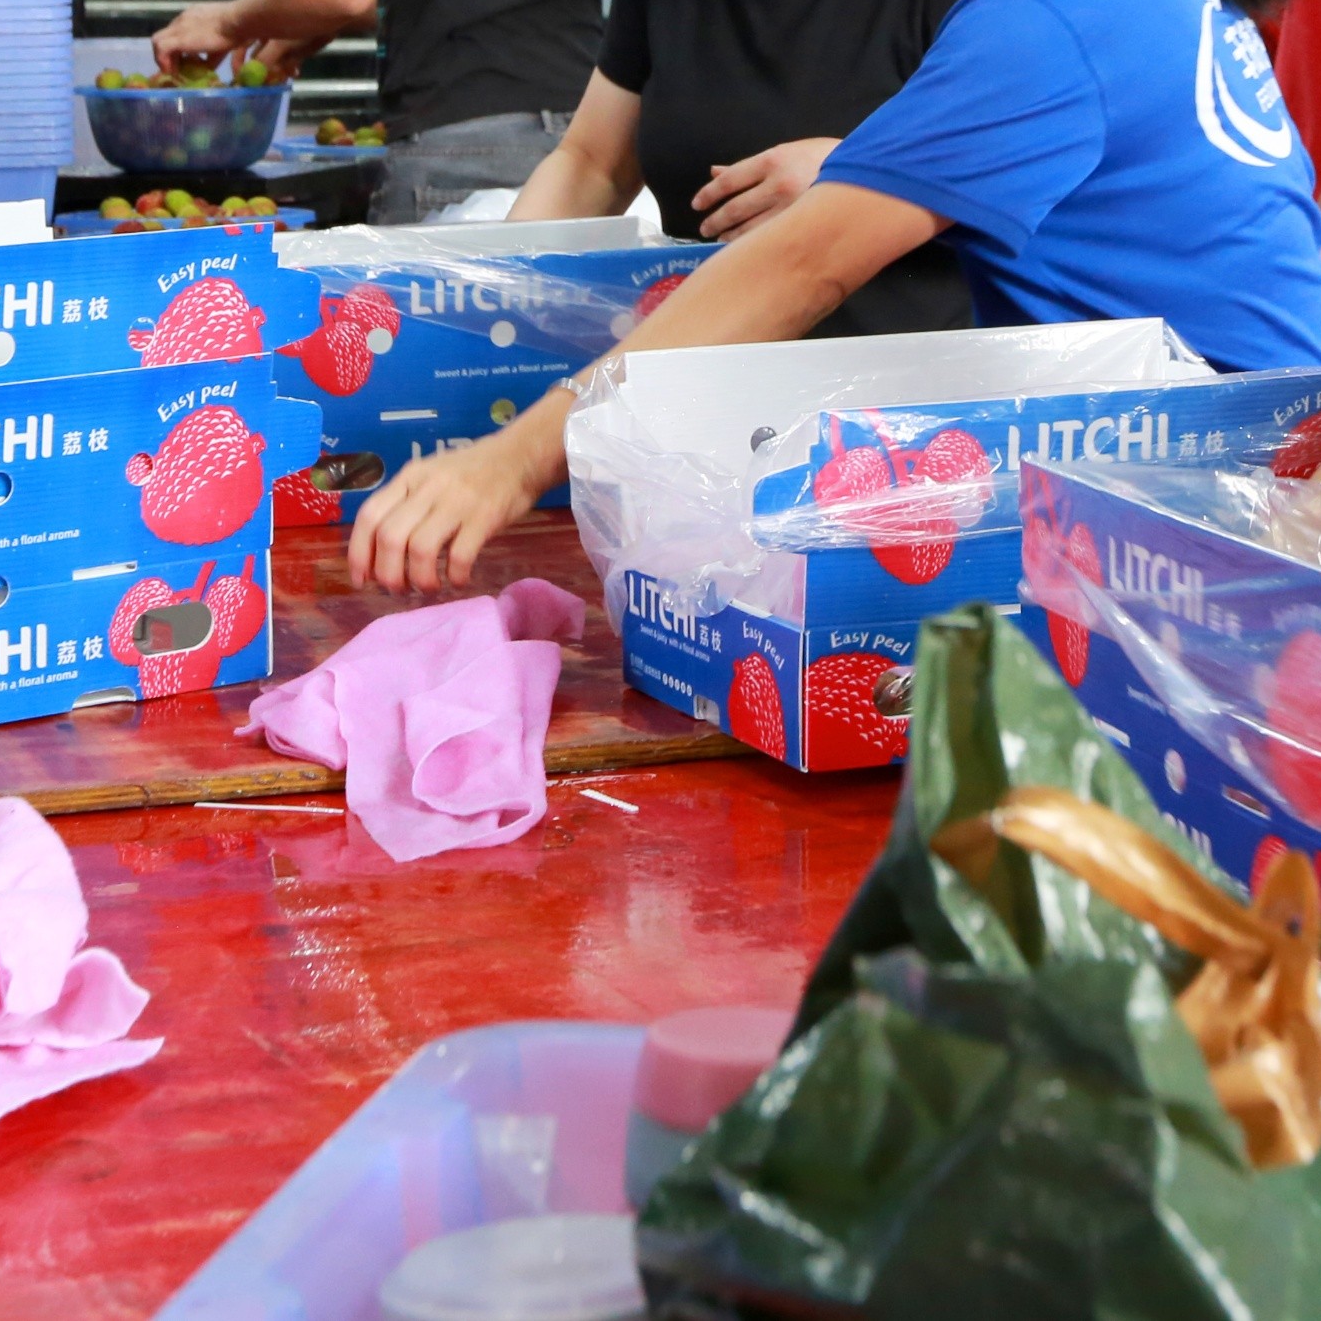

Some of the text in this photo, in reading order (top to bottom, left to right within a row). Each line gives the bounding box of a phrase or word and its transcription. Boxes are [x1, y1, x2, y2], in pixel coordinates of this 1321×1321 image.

[157, 253, 238, 293] Easy peel
[62, 296, 109, 324] 荔枝
[157, 380, 238, 423] Easy peel
[1274, 395, 1309, 426] Easy
[62, 427, 109, 457] 荔枝
[1007, 412, 1227, 471] LITCHI 荔枝
[11, 538, 19, 547] a
[20, 532, 47, 545] floral
[48, 529, 80, 542] aroma
[1108, 534, 1204, 626] LITCHI
[57, 636, 104, 666] 荔枝
[743, 620, 763, 647] Easy
[764, 638, 785, 670] peel
[830, 630, 911, 656] Easy peel
[9, 681, 17, 690] a
[18, 675, 45, 688] floral
[46, 670, 78, 684] aroma
